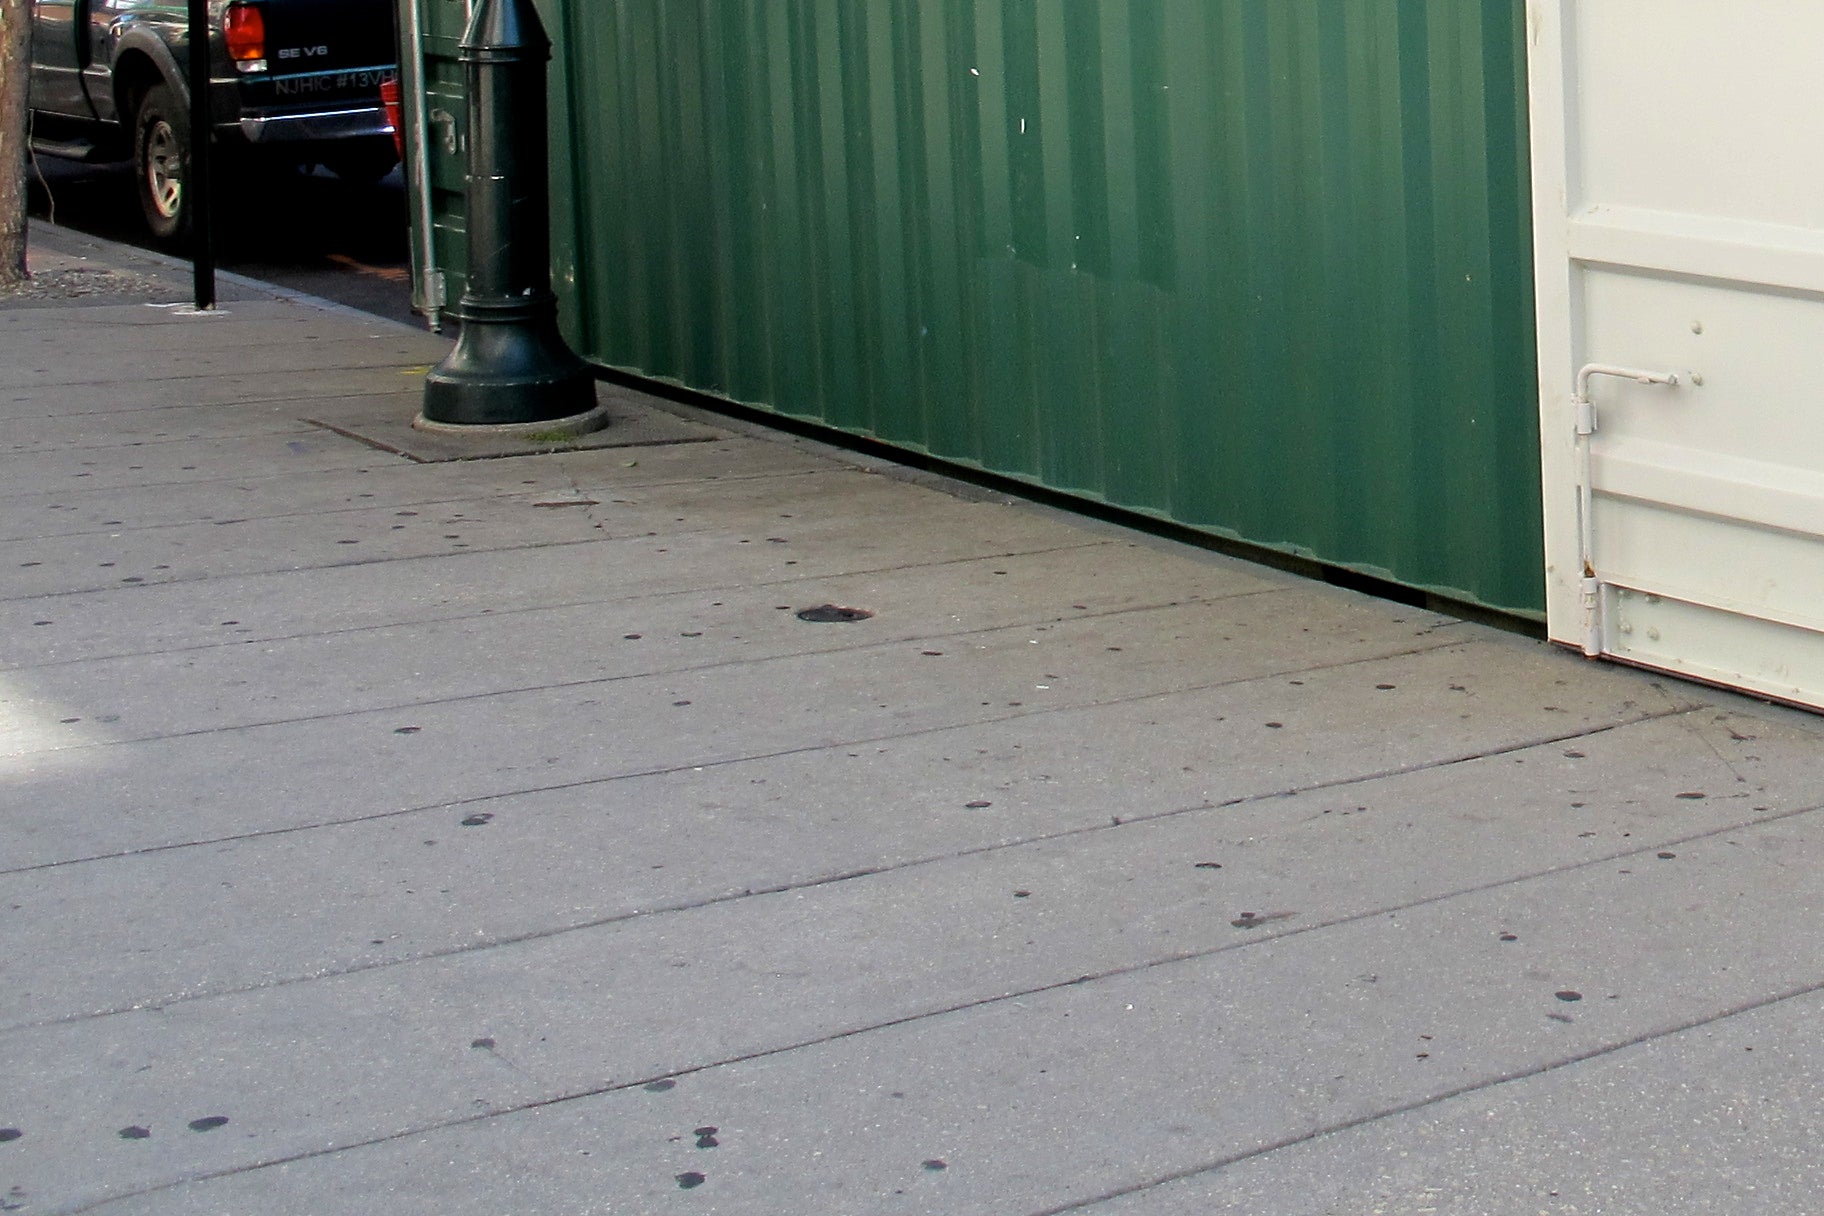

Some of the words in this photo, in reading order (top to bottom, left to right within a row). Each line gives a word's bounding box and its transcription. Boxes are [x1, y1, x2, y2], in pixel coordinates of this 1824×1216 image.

[277, 48, 302, 59] SE
[303, 45, 328, 57] V6
[274, 75, 333, 96] NJHIC
